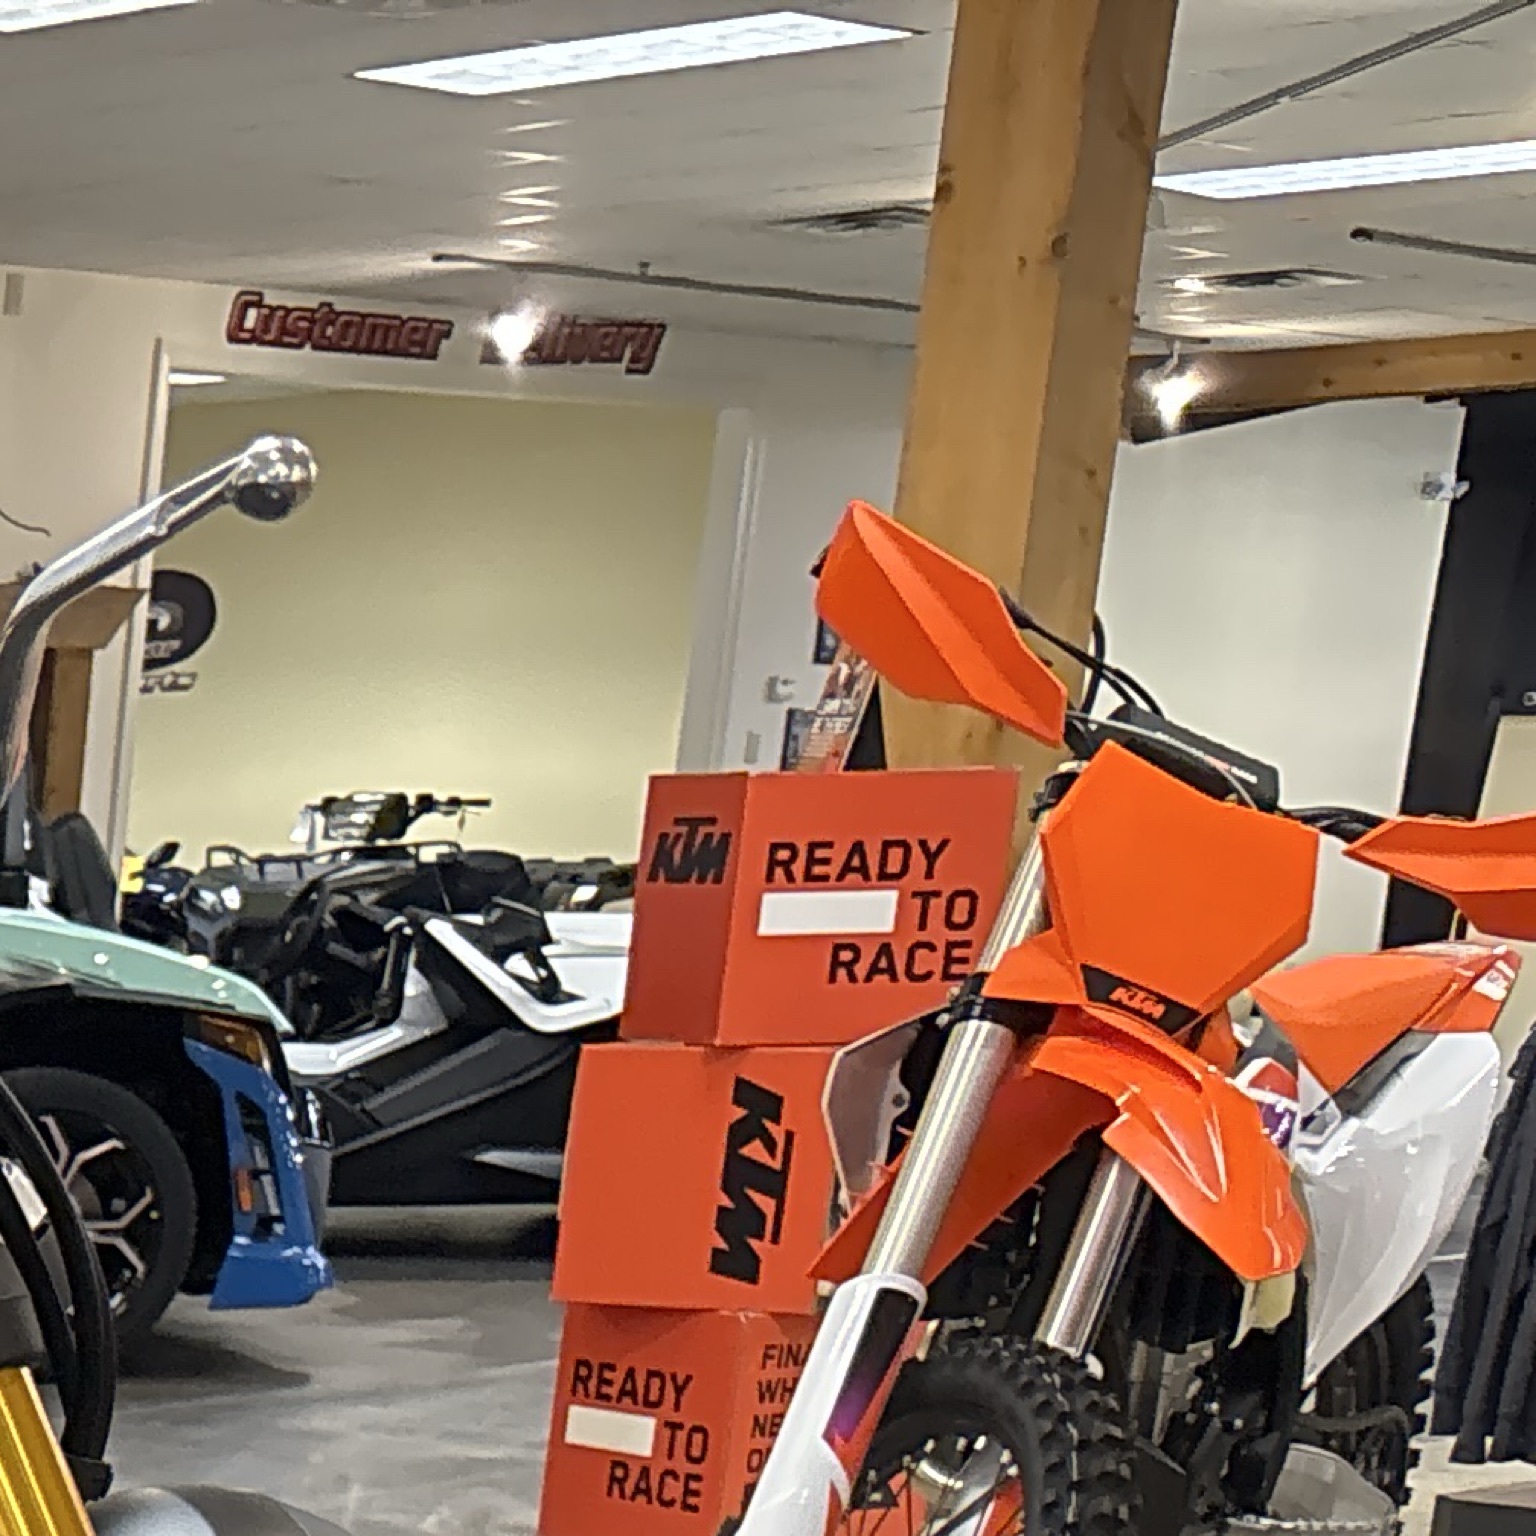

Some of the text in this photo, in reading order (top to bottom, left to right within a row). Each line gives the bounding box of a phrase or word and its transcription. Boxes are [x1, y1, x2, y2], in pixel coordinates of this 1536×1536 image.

[226, 291, 454, 360] Customer
[648, 816, 734, 886] KTM
[764, 838, 951, 884] READY
[911, 890, 978, 932] TO
[828, 939, 975, 985] RACE
[1109, 984, 1168, 1018] KTM
[708, 1074, 795, 1286] KTM
[571, 1358, 694, 1412] READY
[663, 1420, 709, 1465] TO
[606, 1459, 705, 1514] RACE
